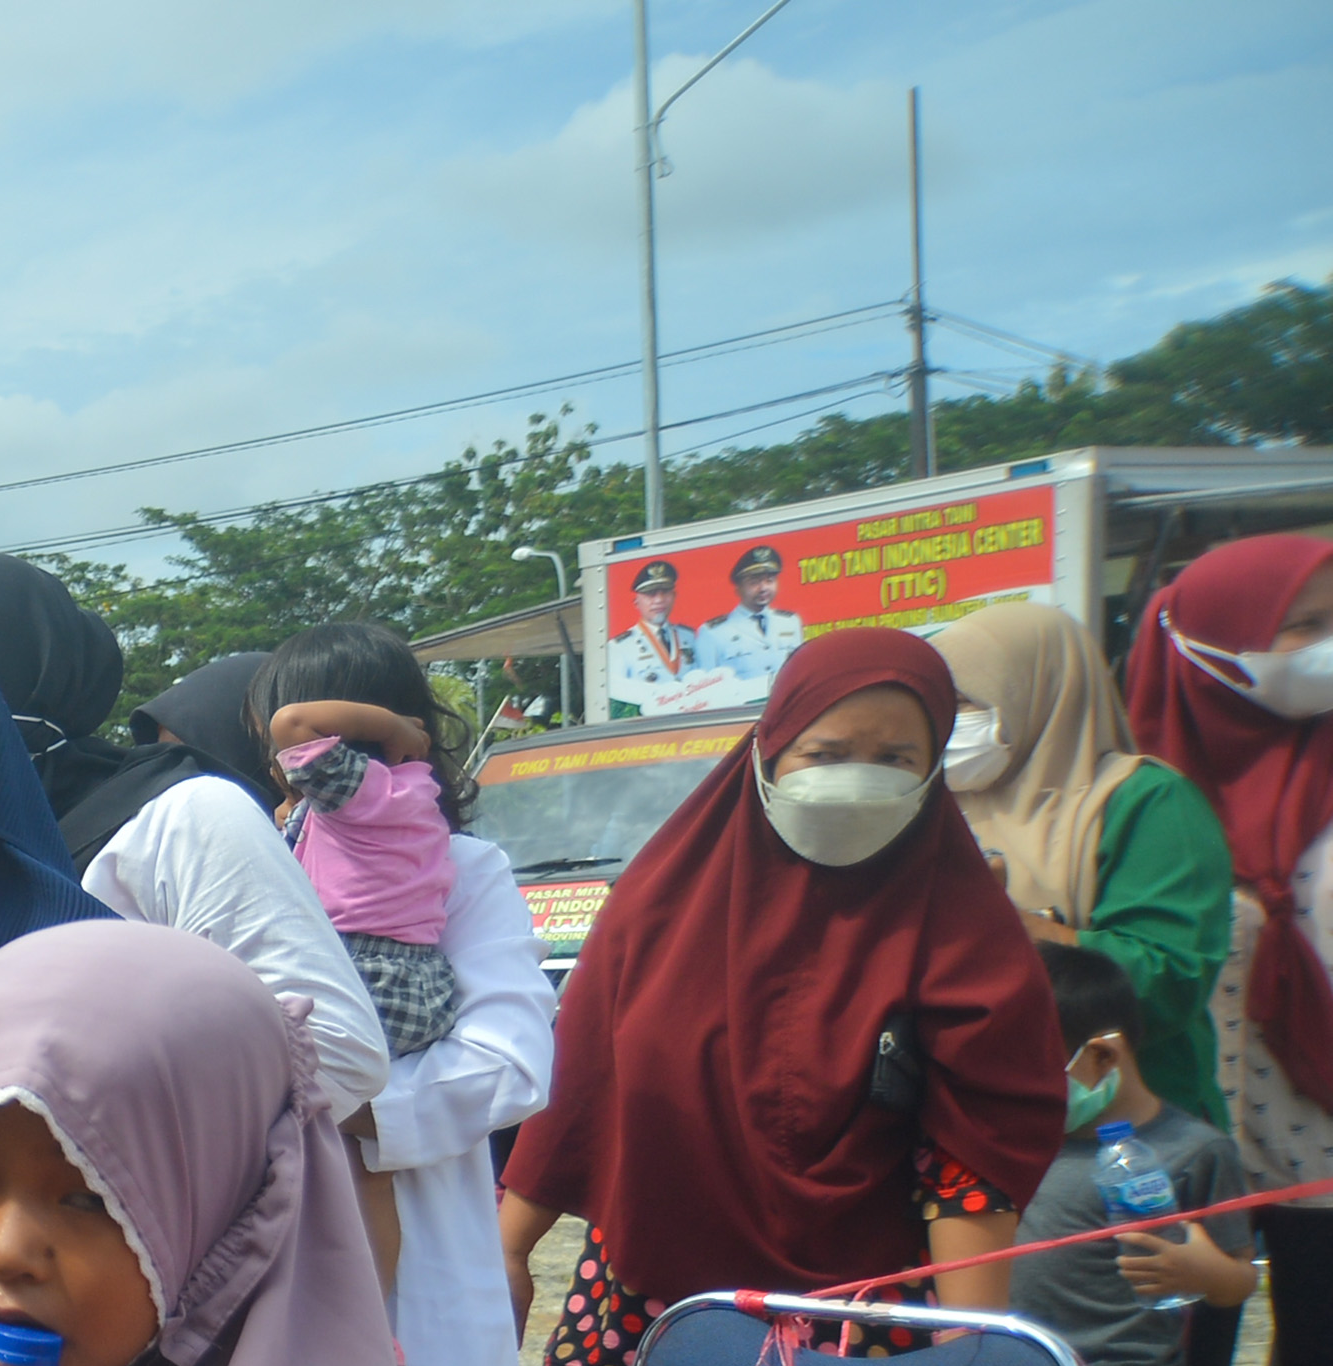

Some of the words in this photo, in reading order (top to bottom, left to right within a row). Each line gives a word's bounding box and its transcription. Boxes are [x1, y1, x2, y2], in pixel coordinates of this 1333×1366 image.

[943, 502, 977, 528] TANI
[798, 553, 841, 584] TOKO
[843, 546, 881, 577] TANI
[882, 531, 972, 570] INDONESIA
[973, 518, 1045, 555] CENTER
[880, 567, 948, 608] (TTIC)
[510, 757, 549, 777] TOKO
[552, 752, 590, 771] TANI
[590, 742, 677, 767] INDONESIA
[679, 735, 744, 756] CENTE
[525, 888, 573, 901] PASAR
[575, 885, 611, 897] MITR
[527, 901, 548, 915] NI
[543, 913, 595, 933] (TTI
[541, 931, 590, 943] PROVINS
